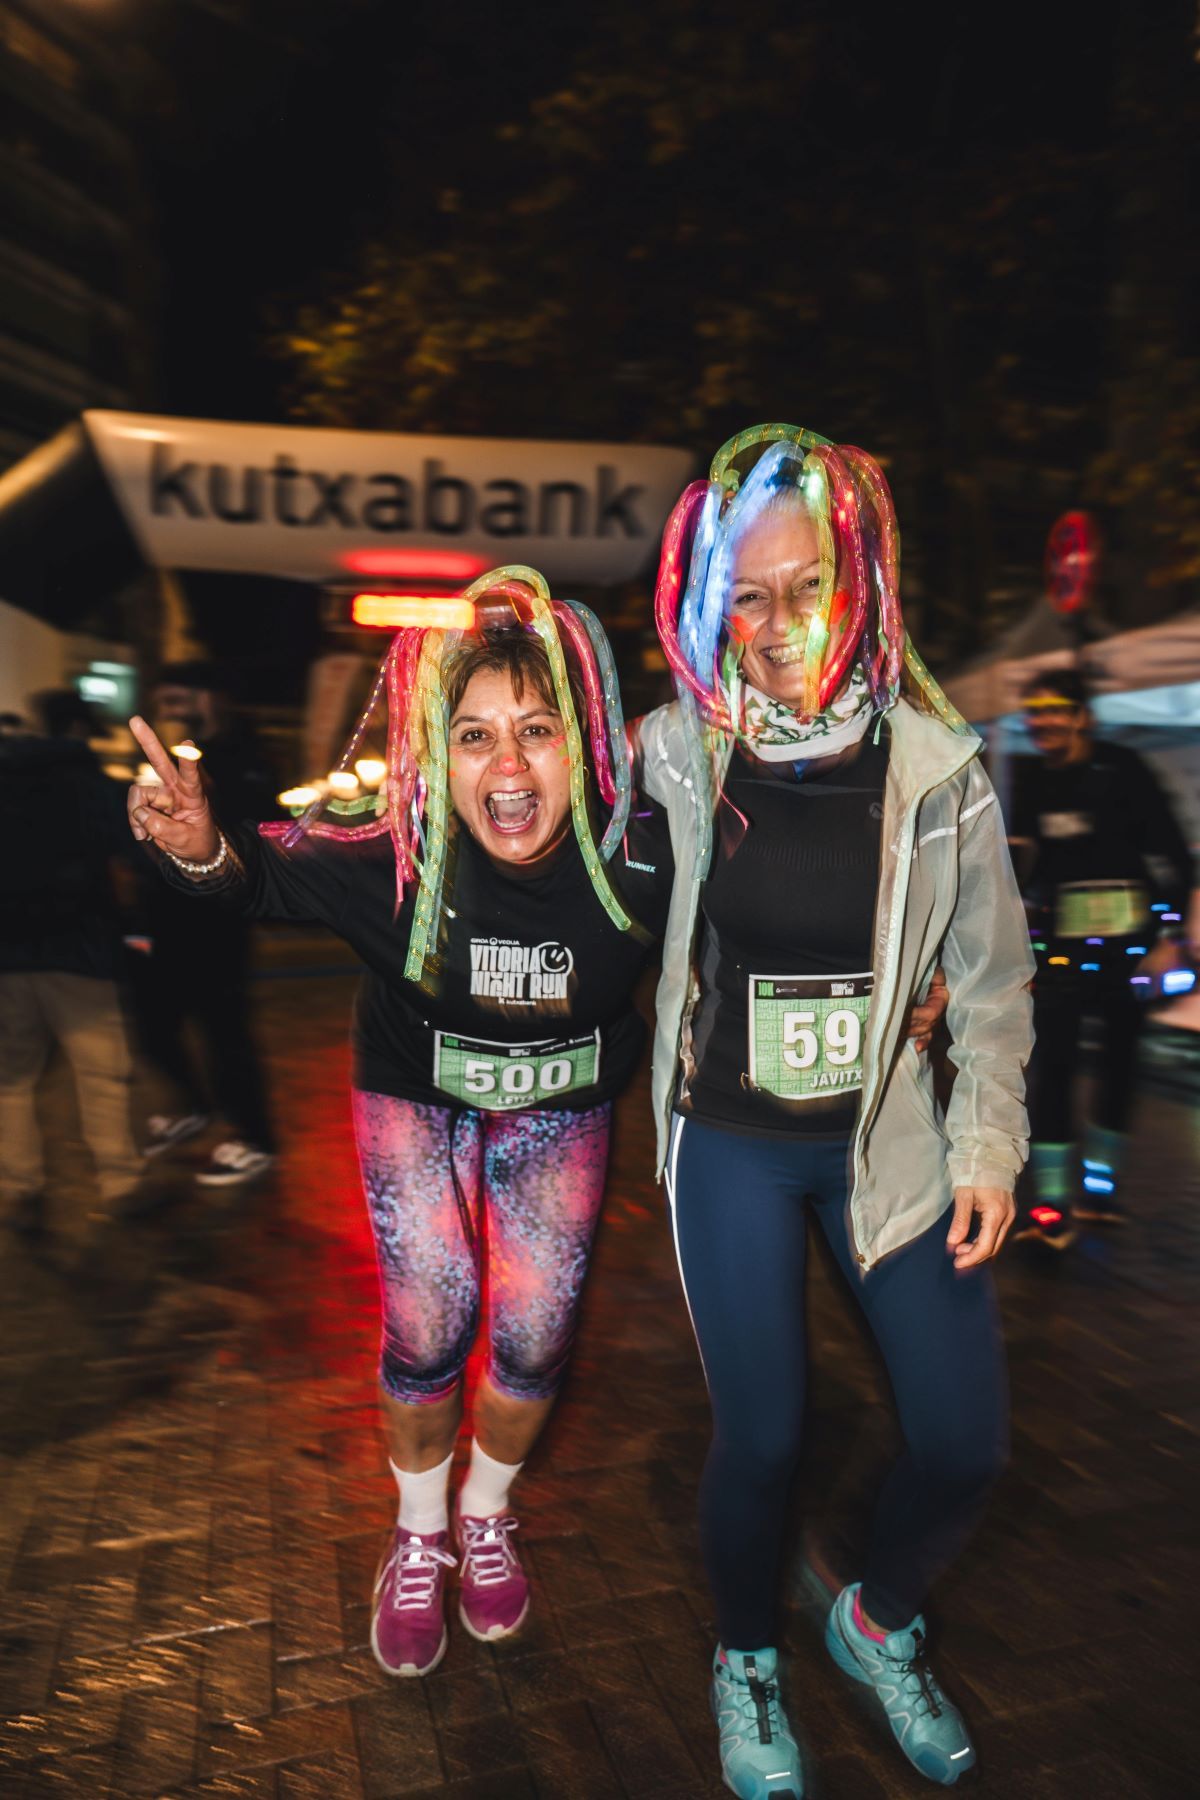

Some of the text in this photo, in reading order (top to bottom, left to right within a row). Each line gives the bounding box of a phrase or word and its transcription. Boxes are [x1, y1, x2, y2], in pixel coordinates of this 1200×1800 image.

[150, 441, 649, 539] kutxabank
[470, 944, 541, 973] VITORIA
[470, 971, 568, 999] NIGHT RUN
[783, 1009, 860, 1069] 59
[464, 1058, 572, 1094] 500
